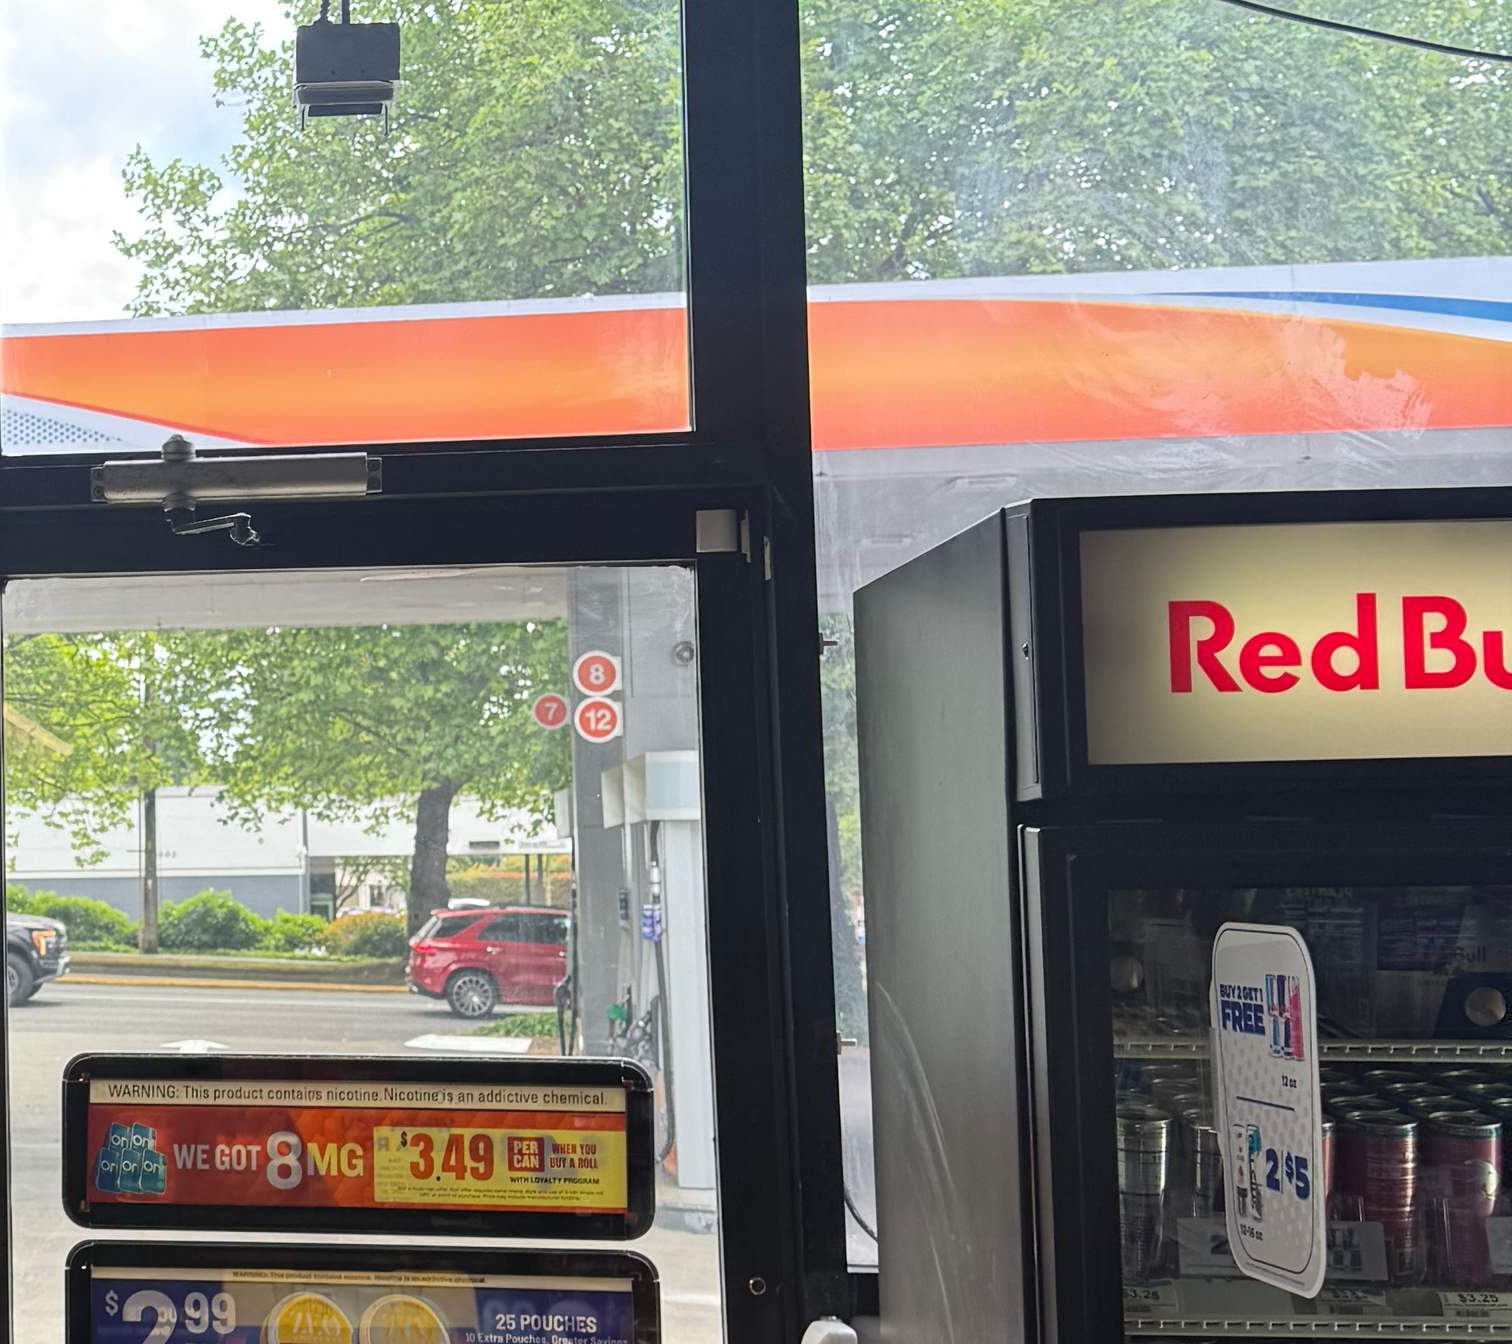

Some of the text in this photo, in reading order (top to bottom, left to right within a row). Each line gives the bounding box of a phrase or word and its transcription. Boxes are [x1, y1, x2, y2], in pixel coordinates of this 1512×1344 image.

[1169, 593, 1378, 693] Red
[588, 663, 606, 686] 8
[544, 703, 557, 720] 7
[584, 708, 610, 731] 12
[1220, 983, 1237, 998] BUY
[1243, 986, 1259, 1002] GET
[1221, 1000, 1266, 1035] FREE
[108, 1084, 179, 1099] WARNING:
[185, 1085, 209, 1099] This
[213, 1086, 263, 1102] product
[384, 1090, 438, 1102] Nicotine
[441, 1091, 453, 1103] is
[457, 1093, 473, 1104] an
[478, 1091, 538, 1104] addictive
[543, 1093, 607, 1106] chemical.
[513, 1141, 538, 1154] PER
[551, 1143, 597, 1155] WHEN YOU
[173, 1144, 209, 1170] WE
[215, 1145, 260, 1171] GOT
[266, 1131, 303, 1190] 8
[307, 1142, 364, 1177] MG
[514, 1156, 539, 1169] CAN
[550, 1156, 599, 1169] BUY ROLL
[563, 1177, 600, 1185] PROGRAM
[1458, 1292, 1499, 1304] $3.25
[496, 1314, 597, 1335] 25 POUCHES
[465, 1332, 476, 1343] 10
[478, 1333, 504, 1344] Extra
